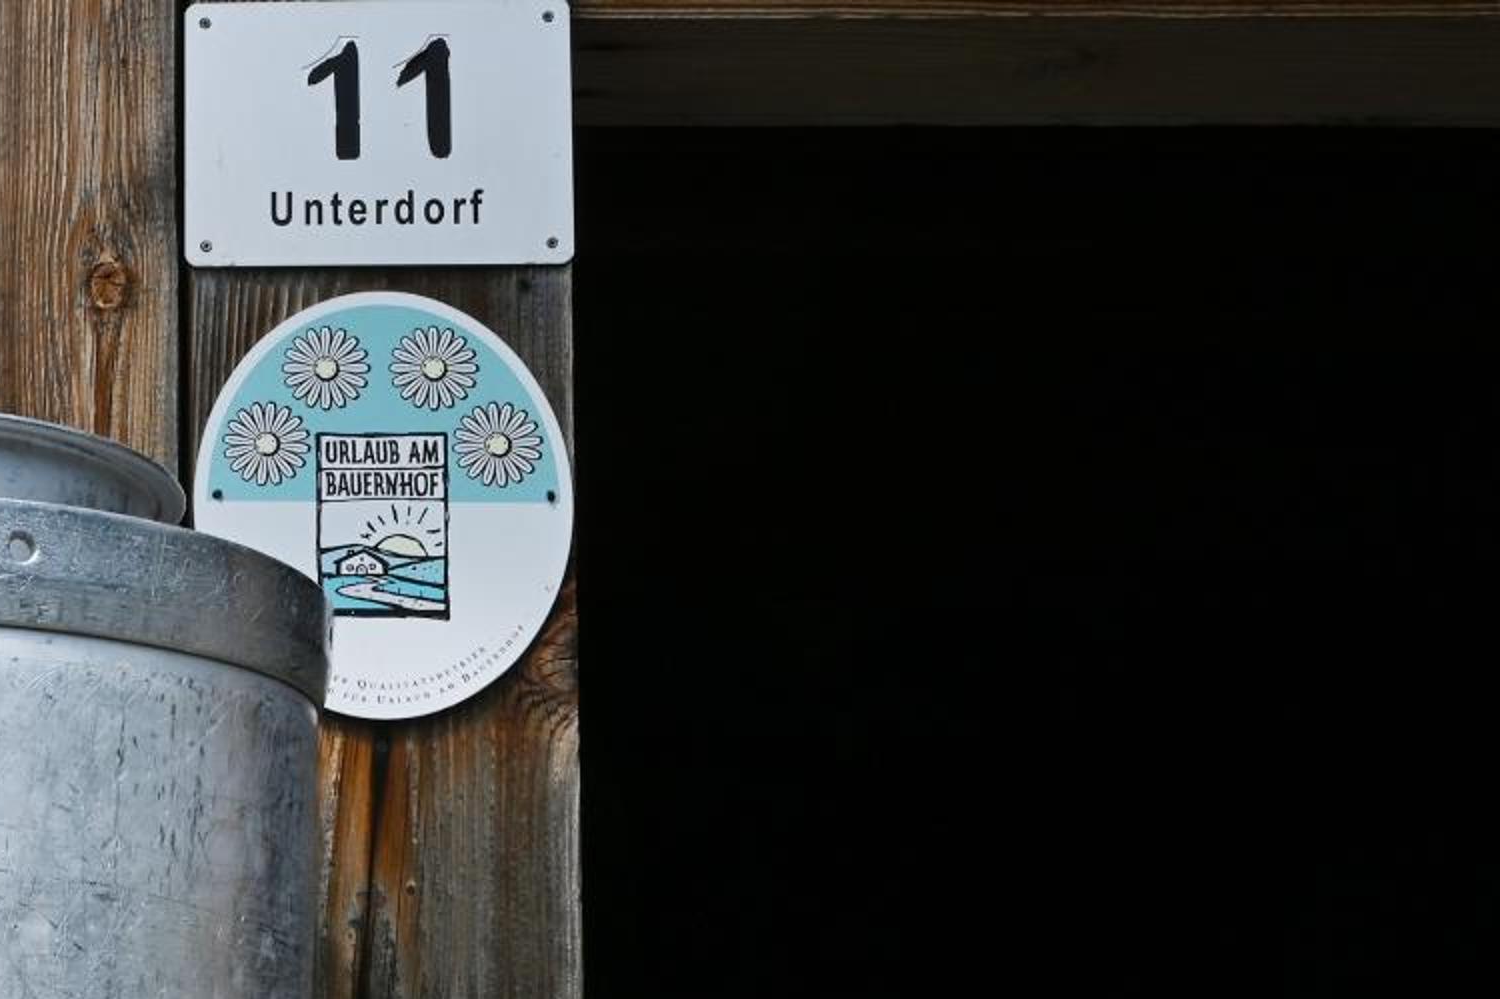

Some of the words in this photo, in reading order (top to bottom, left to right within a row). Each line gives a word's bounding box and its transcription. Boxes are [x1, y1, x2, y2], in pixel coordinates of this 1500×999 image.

[304, 36, 452, 160] 11
[270, 189, 485, 227] Unterdorf
[325, 440, 400, 465] URLAUB
[409, 440, 439, 464] AM
[325, 471, 439, 497] BAUERNHOF
